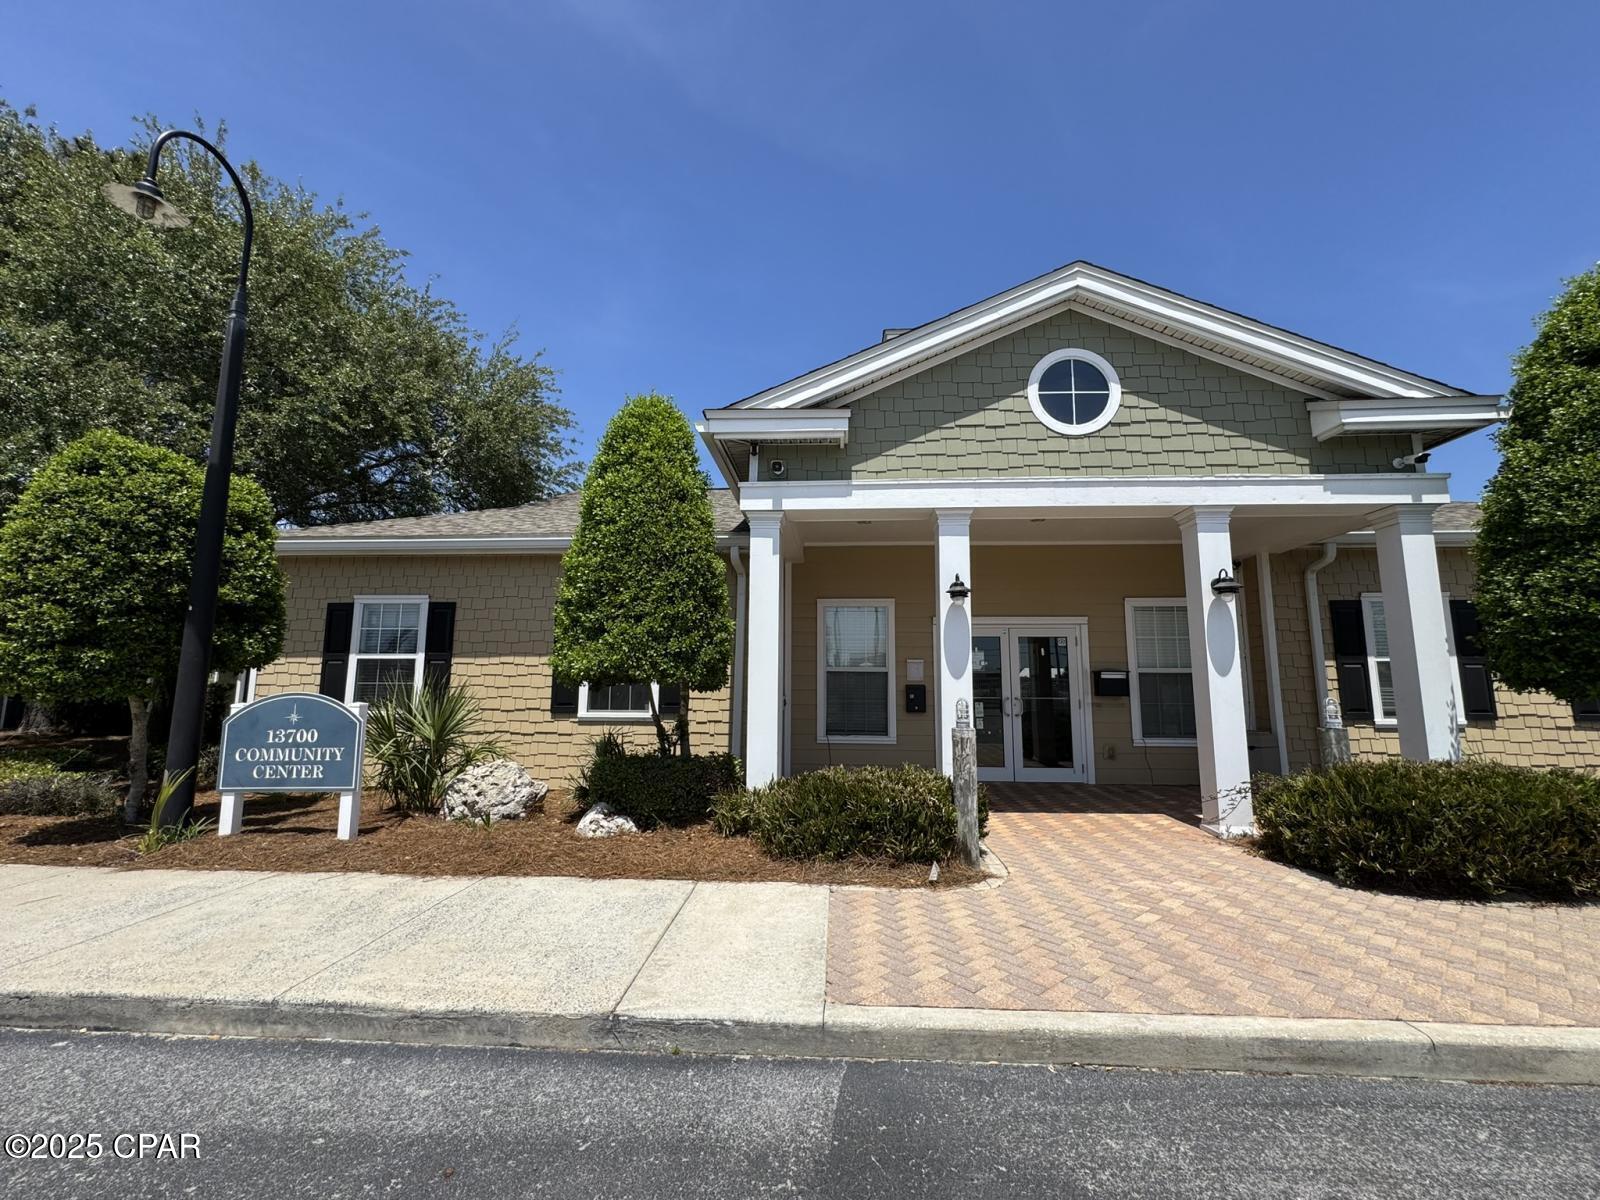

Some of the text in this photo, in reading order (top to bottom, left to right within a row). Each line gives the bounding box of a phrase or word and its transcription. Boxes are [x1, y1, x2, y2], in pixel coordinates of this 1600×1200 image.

[266, 728, 318, 743] 13700
[235, 747, 345, 762] COMMUNITY
[252, 764, 324, 779] CENTER
